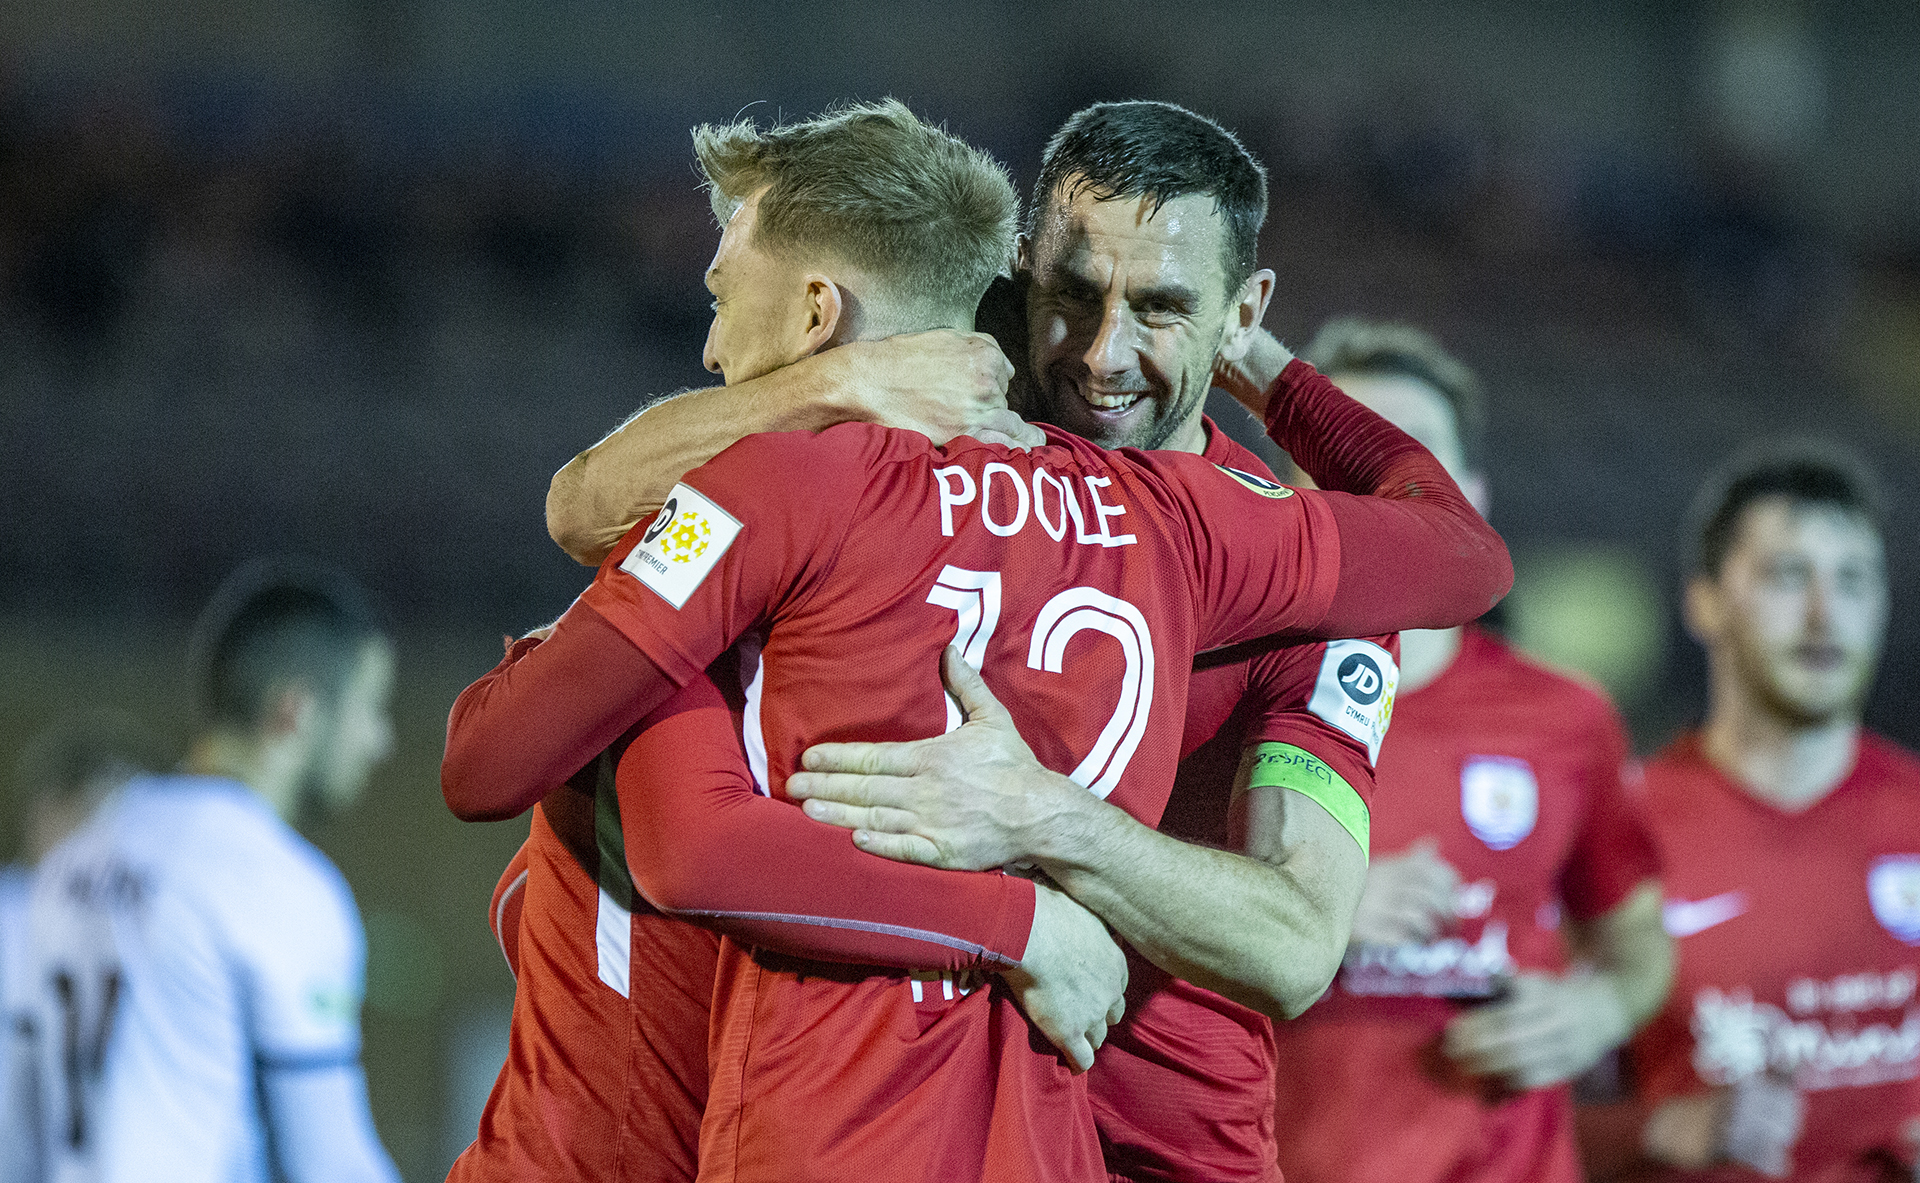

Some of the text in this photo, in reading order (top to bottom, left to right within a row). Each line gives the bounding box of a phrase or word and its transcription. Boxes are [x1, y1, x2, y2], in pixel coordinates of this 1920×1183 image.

[933, 462, 1137, 548] POOLE
[926, 564, 1155, 801] 12
[1341, 663, 1379, 694] JD
[1345, 705, 1370, 727] CYMRU
